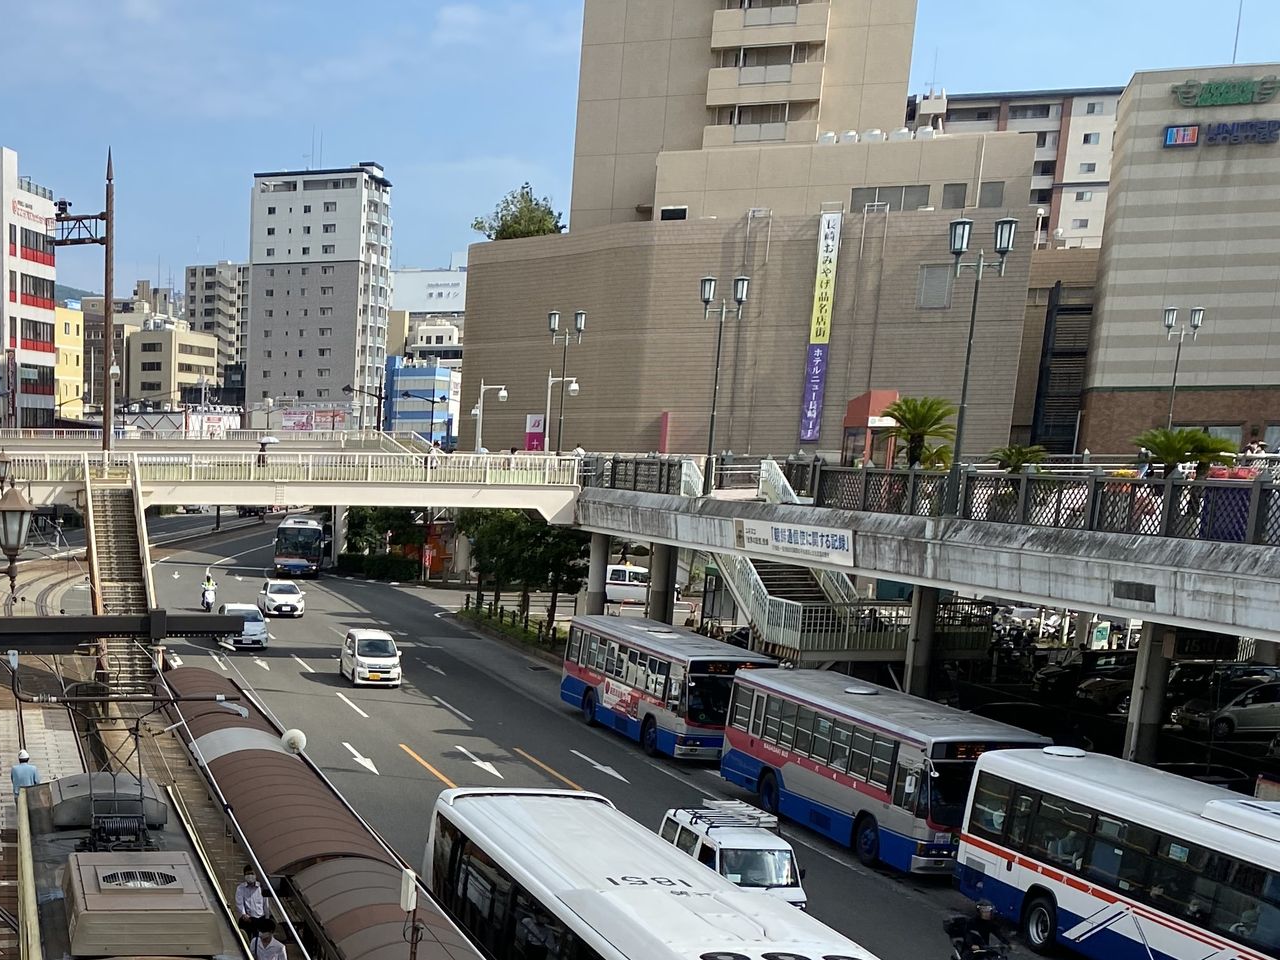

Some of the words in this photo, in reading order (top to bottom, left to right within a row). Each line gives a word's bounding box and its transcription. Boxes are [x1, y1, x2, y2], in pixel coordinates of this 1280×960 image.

[815, 218, 837, 338] 長崎おみやげ品名店街
